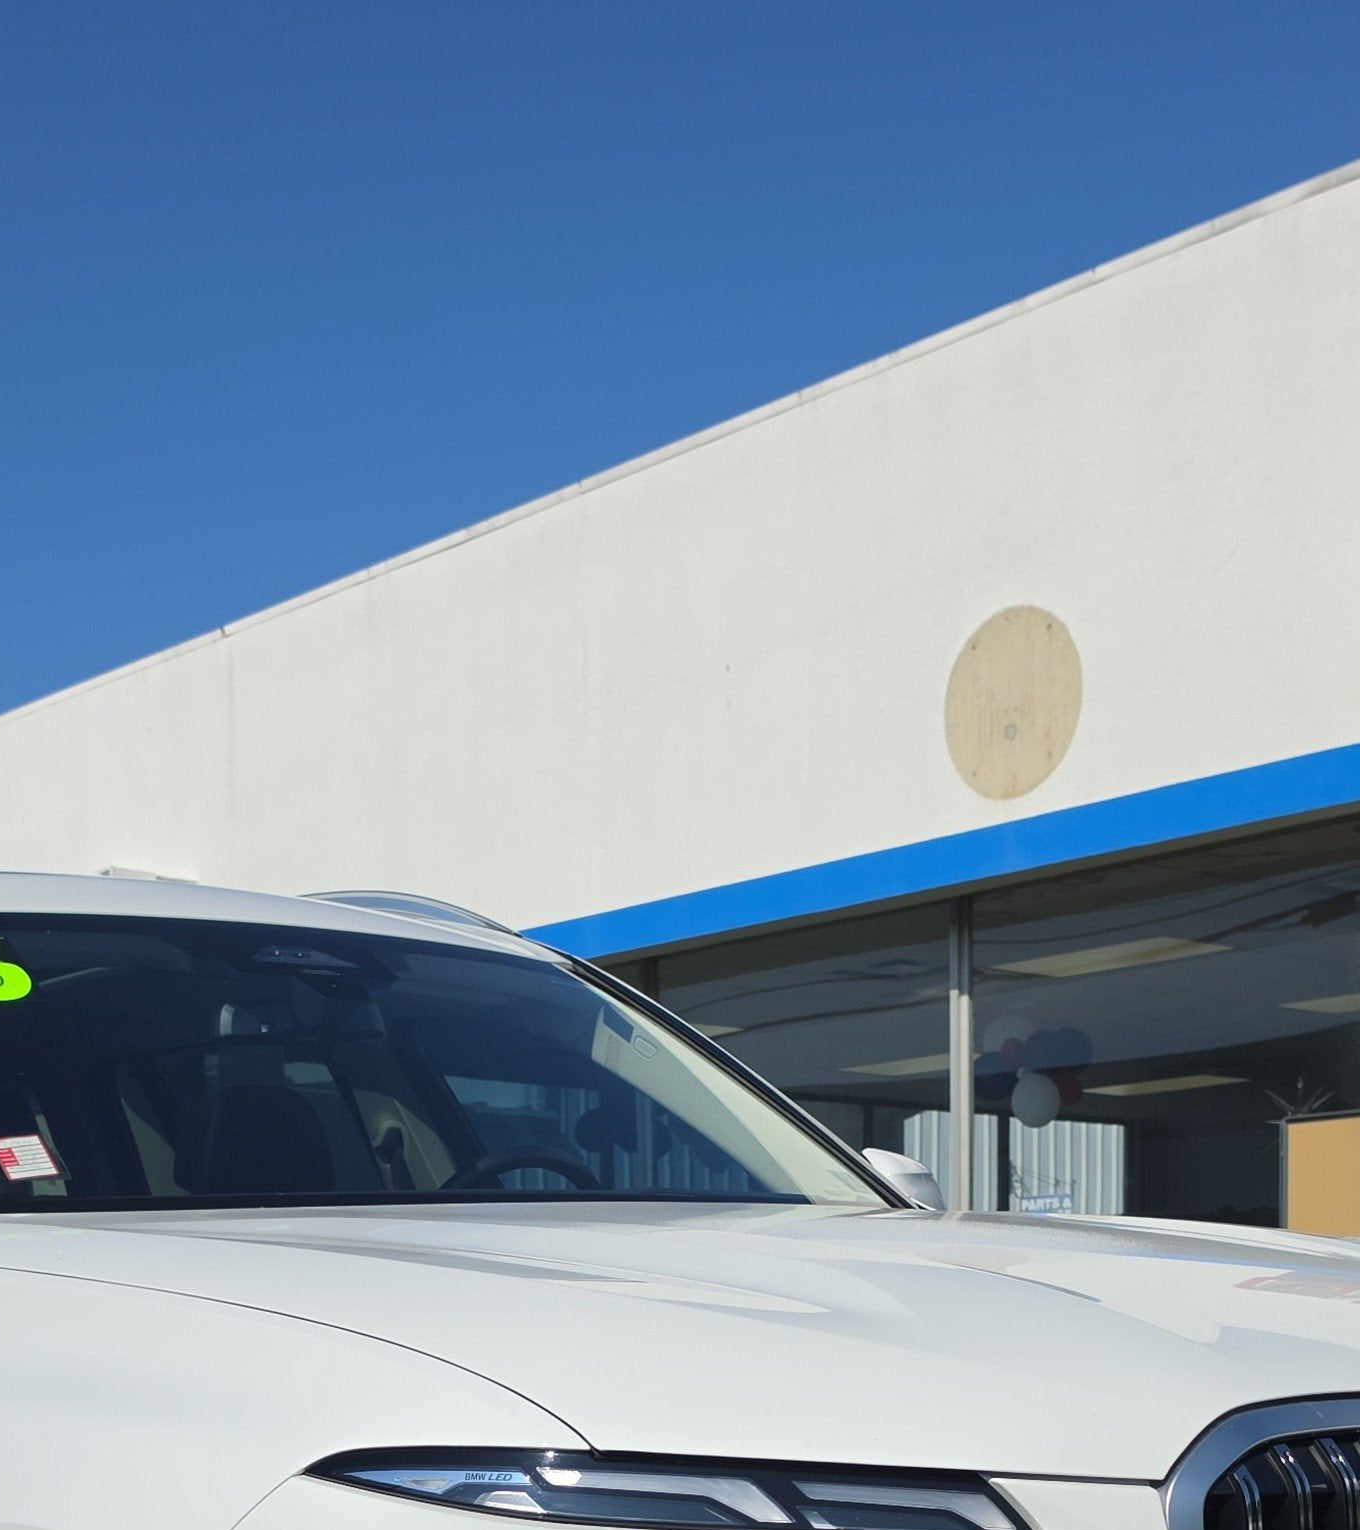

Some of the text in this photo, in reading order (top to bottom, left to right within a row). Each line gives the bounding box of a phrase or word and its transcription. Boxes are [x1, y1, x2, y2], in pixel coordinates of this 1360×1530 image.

[1022, 1197, 1060, 1212] PARTS
[465, 1472, 513, 1481] BMW LED
